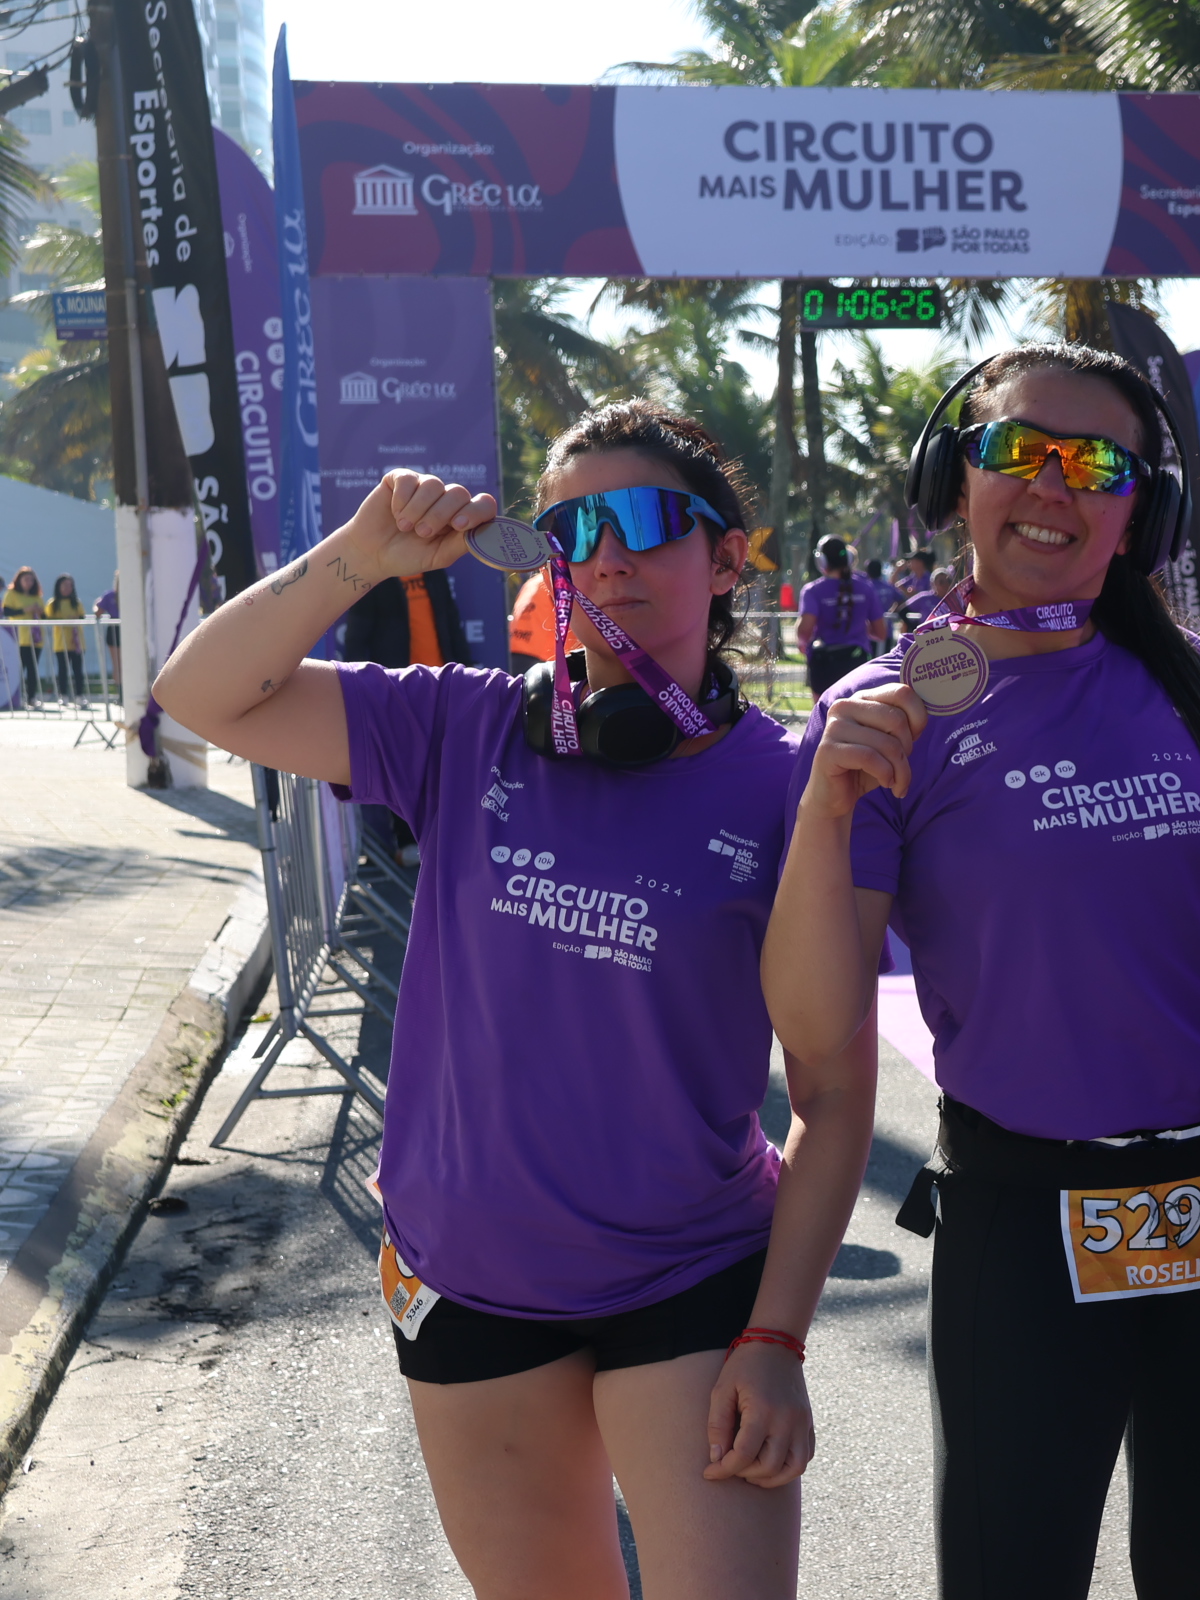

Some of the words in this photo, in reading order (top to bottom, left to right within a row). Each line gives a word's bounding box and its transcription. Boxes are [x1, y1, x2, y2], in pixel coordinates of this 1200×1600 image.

[145, 1, 187, 201] Secretaria
[175, 213, 197, 263] de
[722, 119, 994, 165] CIRCUITO
[130, 88, 163, 268] Esportes
[699, 175, 777, 199] MAIS
[782, 168, 1029, 213] MULHER
[951, 224, 982, 240] SÃO
[984, 227, 1030, 241] PAULO
[235, 350, 277, 501] CIRCUITO
[1036, 603, 1074, 620] CIRCUITO
[1047, 615, 1077, 631] MULHER
[925, 636, 945, 646] 2024
[912, 674, 928, 683] MAIS
[928, 658, 976, 680] MULHER
[915, 651, 967, 675] CIRCUITO
[658, 690, 686, 721] PAULO
[667, 683, 694, 713] TODAS
[1152, 752, 1192, 762] 2024
[1041, 771, 1182, 810] CIRCUITO
[1033, 811, 1078, 832] MAIS
[1171, 819, 1187, 830] SÃO
[719, 828, 760, 849] Realização:
[1112, 830, 1143, 842] EDIÇÃO:
[734, 855, 759, 869] PAULO
[736, 848, 753, 859] SÃO
[506, 873, 649, 920] CIRCUITO
[634, 874, 683, 897] 2024
[490, 897, 528, 917] MAIS
[528, 901, 658, 952] MULHER
[552, 941, 584, 954] EDIÇÃO:
[613, 948, 629, 960] SÃO
[628, 953, 653, 966] PAULO
[1125, 1258, 1200, 1286] ROSELI
[406, 1297, 424, 1321] 5346
